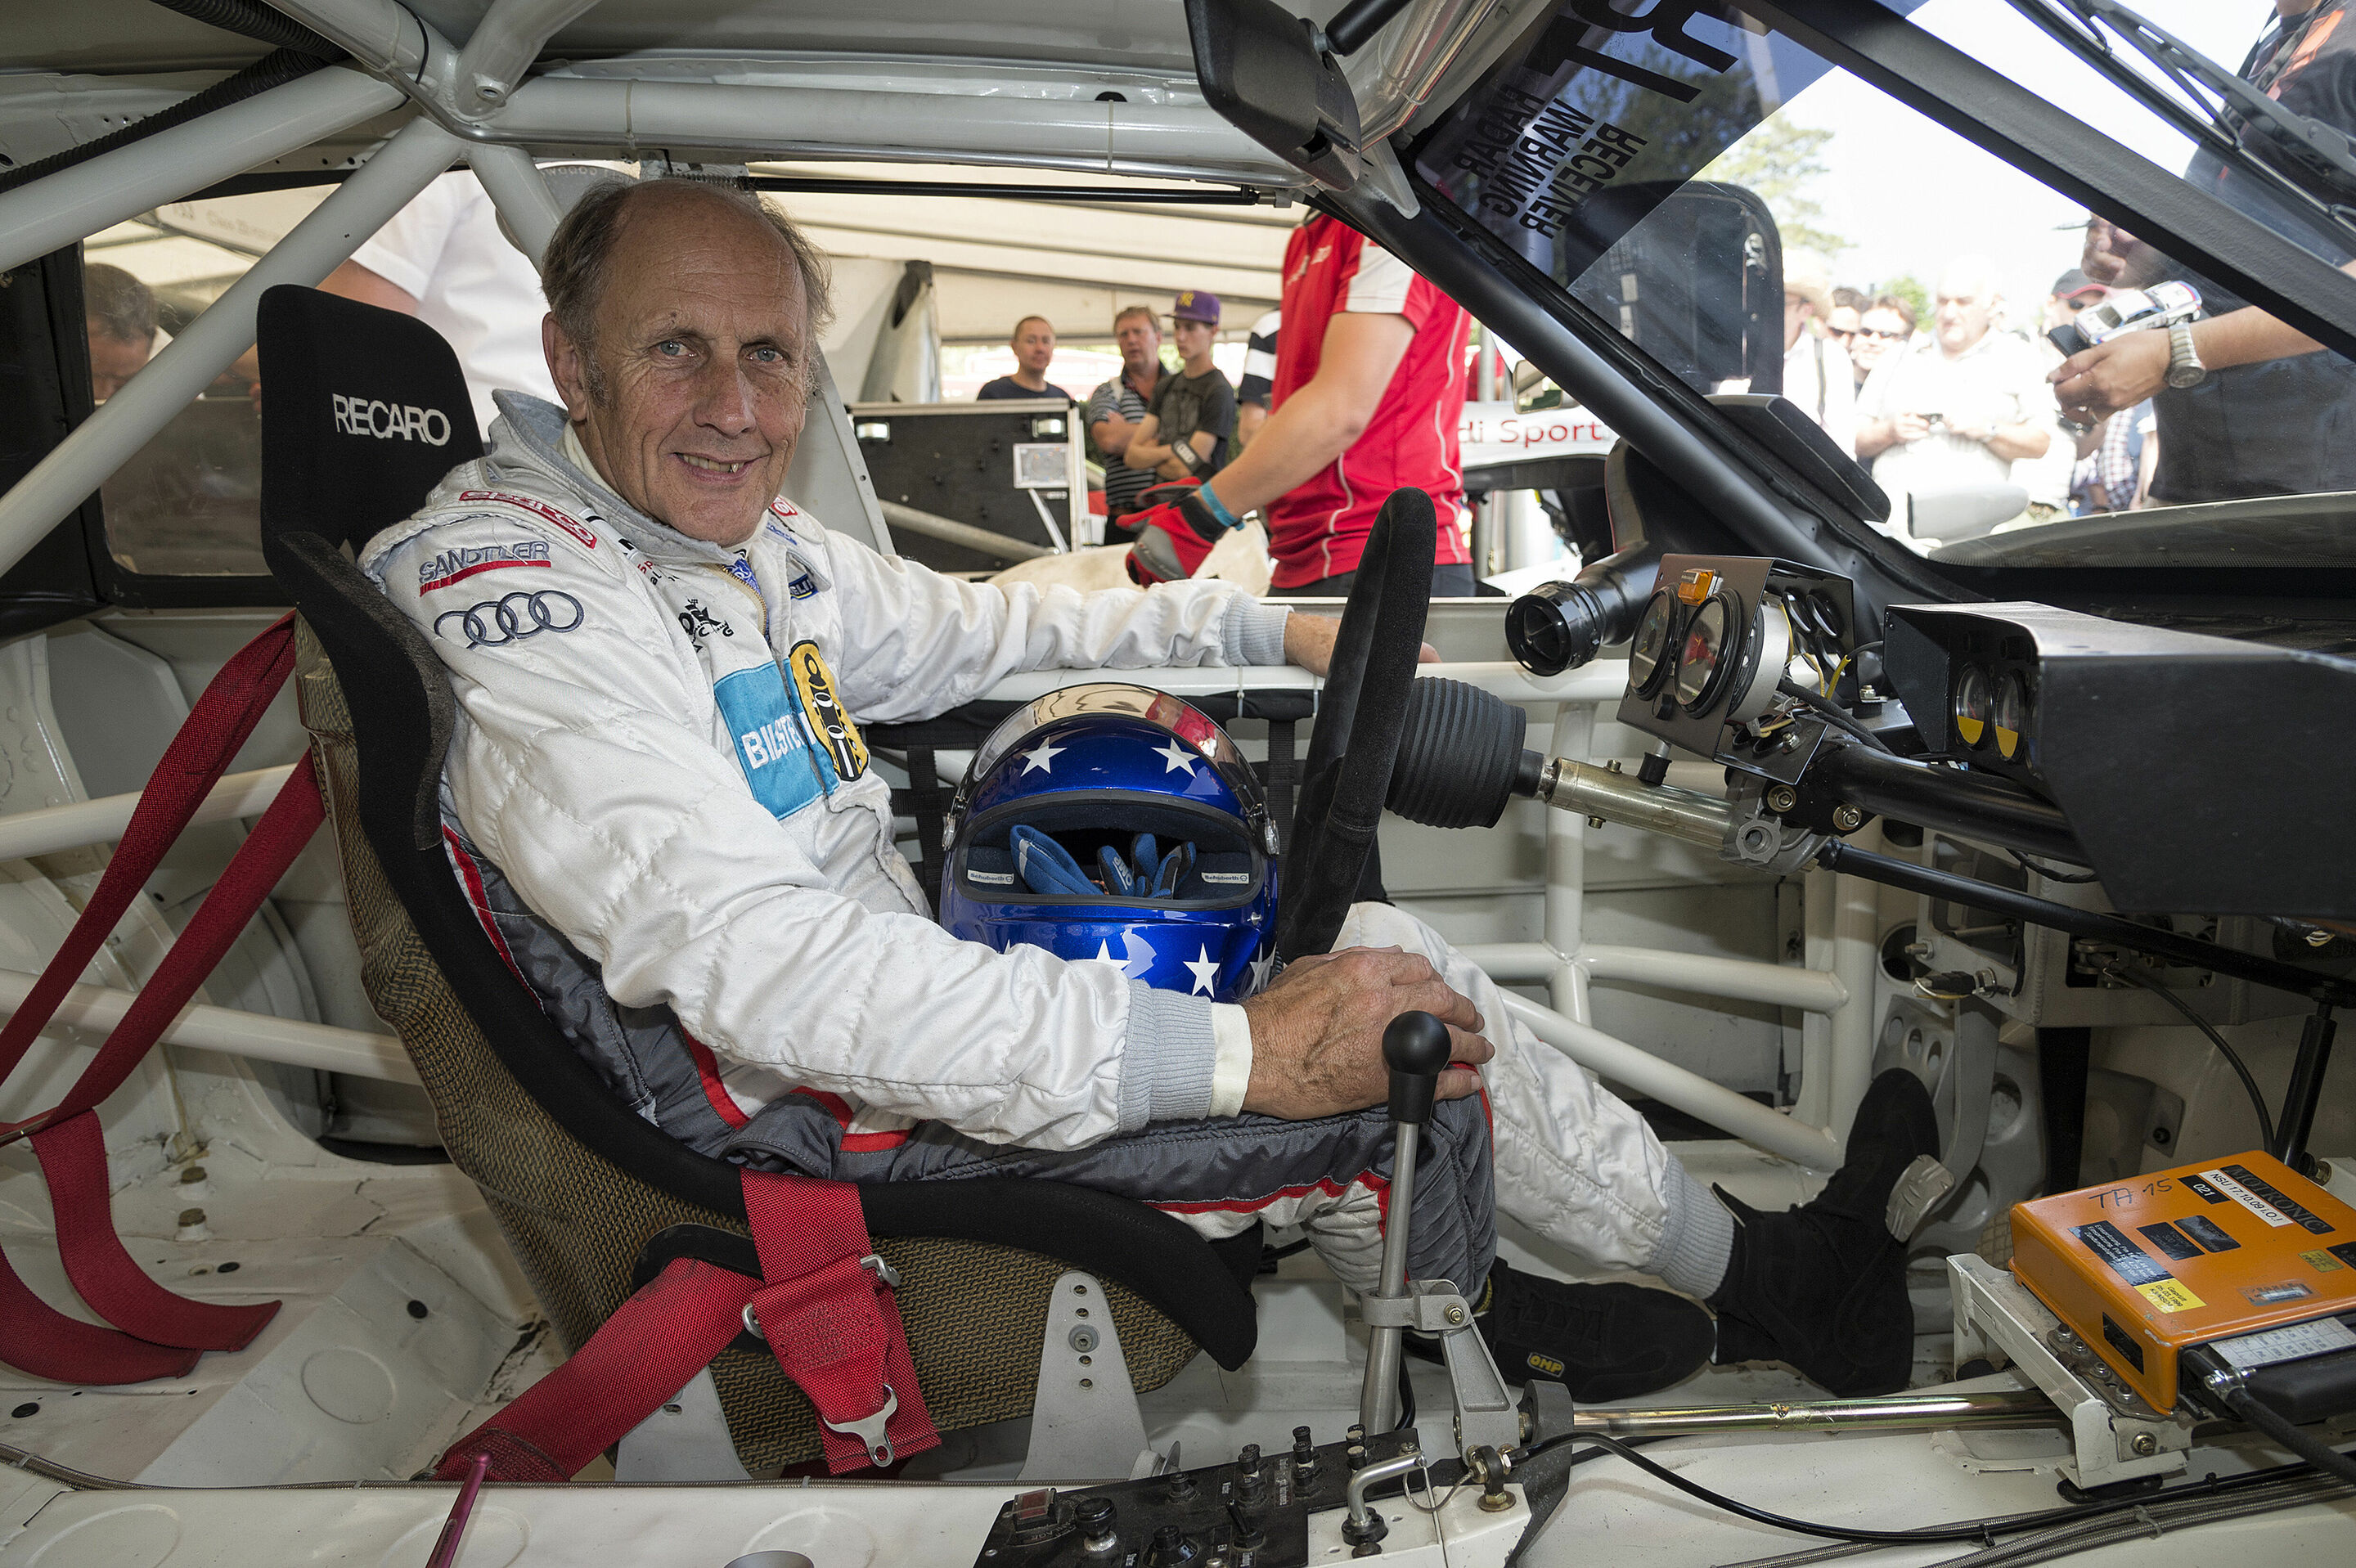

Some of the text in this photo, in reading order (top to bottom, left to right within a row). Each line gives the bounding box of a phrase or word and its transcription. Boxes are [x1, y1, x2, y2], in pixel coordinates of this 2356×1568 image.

[332, 393, 452, 447] RECARO
[1499, 420, 1604, 447] Sport
[2142, 1178, 2173, 1196] 15
[2193, 1184, 2216, 1197] 021
[2210, 1173, 2232, 1187] NSU
[2228, 1186, 2264, 1209] 17.10.09
[2230, 1167, 2327, 1230] MOTRONIC
[1530, 1355, 1562, 1373] OMP
